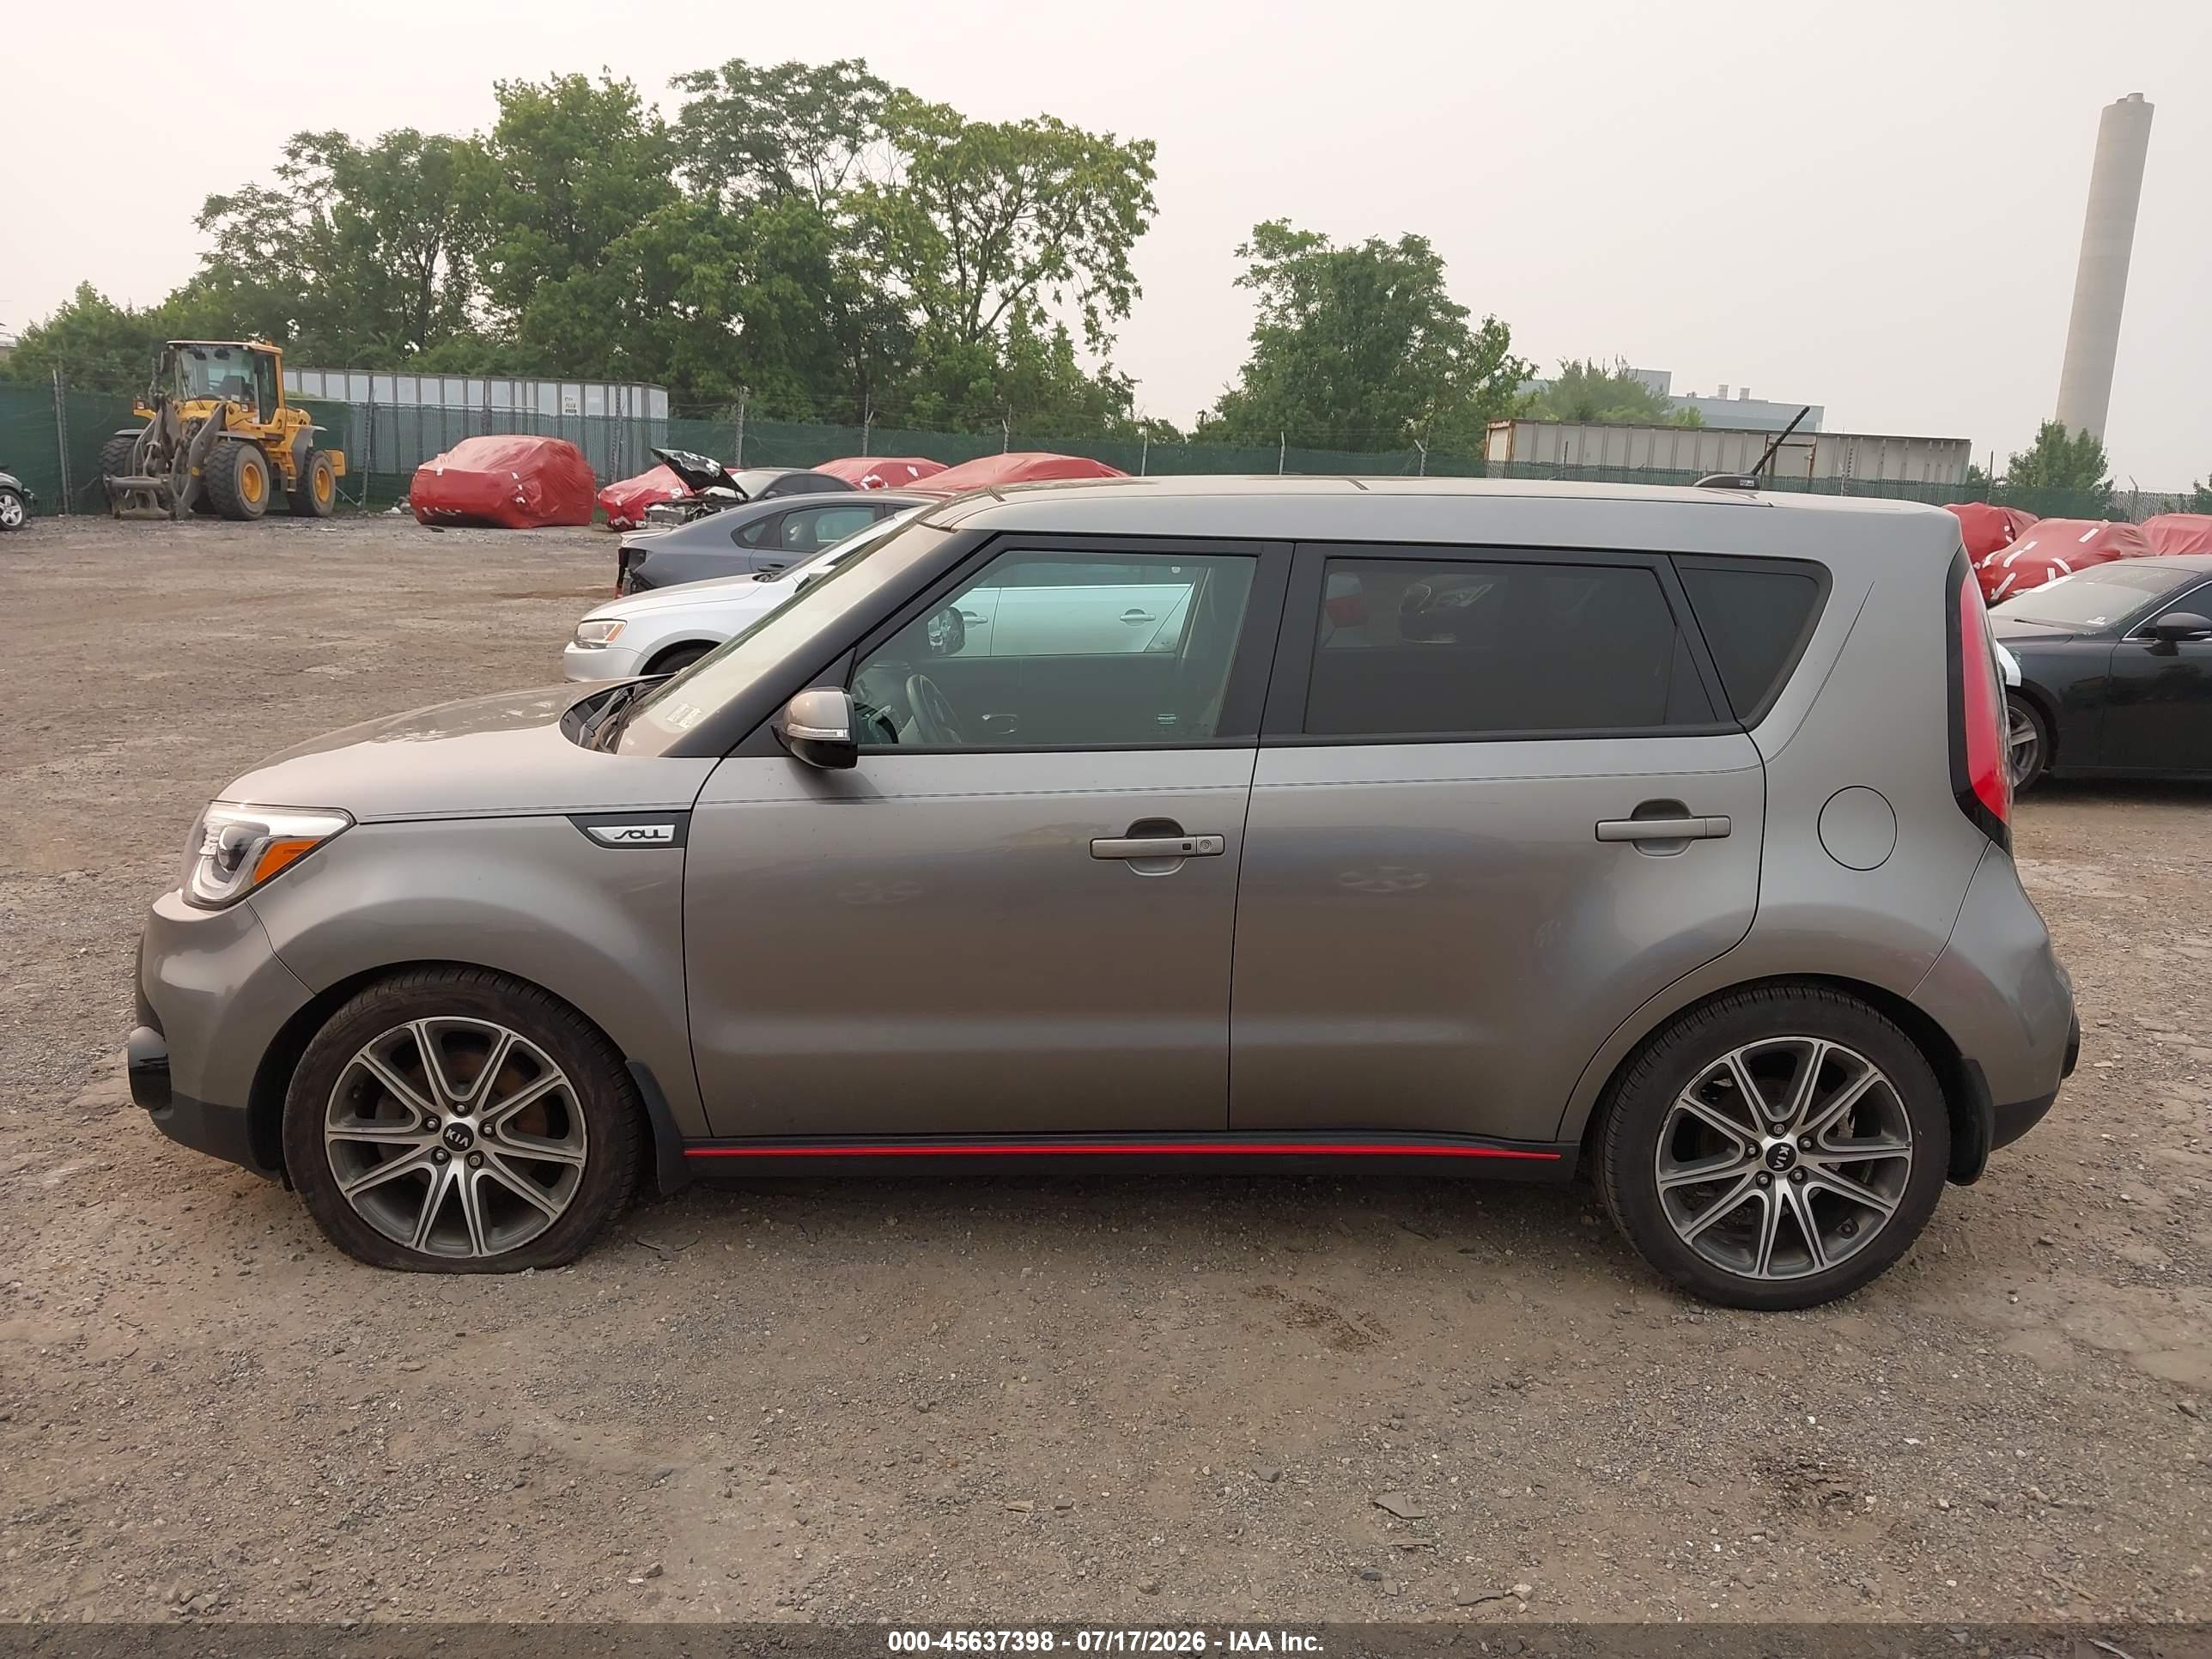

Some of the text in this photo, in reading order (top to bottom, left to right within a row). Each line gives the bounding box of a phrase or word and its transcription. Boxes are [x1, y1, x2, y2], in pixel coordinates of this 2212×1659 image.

[614, 829, 669, 840] SOUL
[446, 1127, 469, 1147] KIA
[1773, 1146, 1790, 1168] KIA
